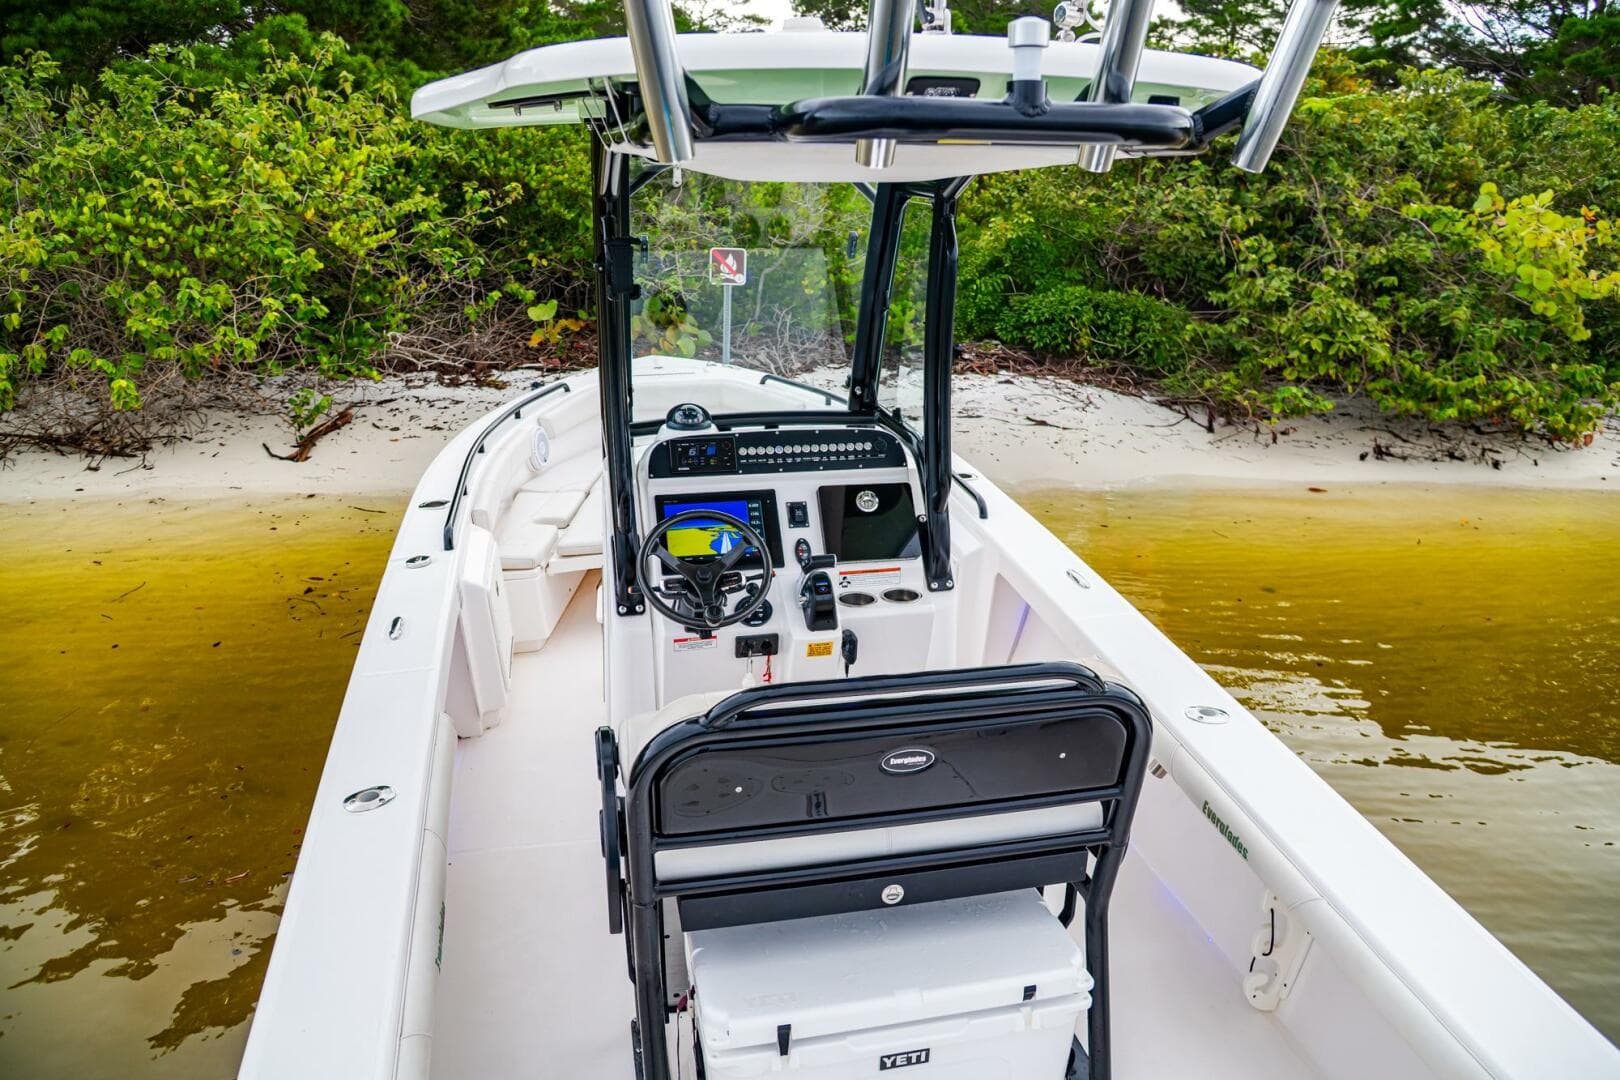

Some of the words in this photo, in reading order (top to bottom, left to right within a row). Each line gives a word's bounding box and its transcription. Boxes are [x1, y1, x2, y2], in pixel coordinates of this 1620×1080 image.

[890, 755, 927, 765] Everglades
[1202, 800, 1248, 860] Everglades
[882, 1051, 926, 1068] YETI
